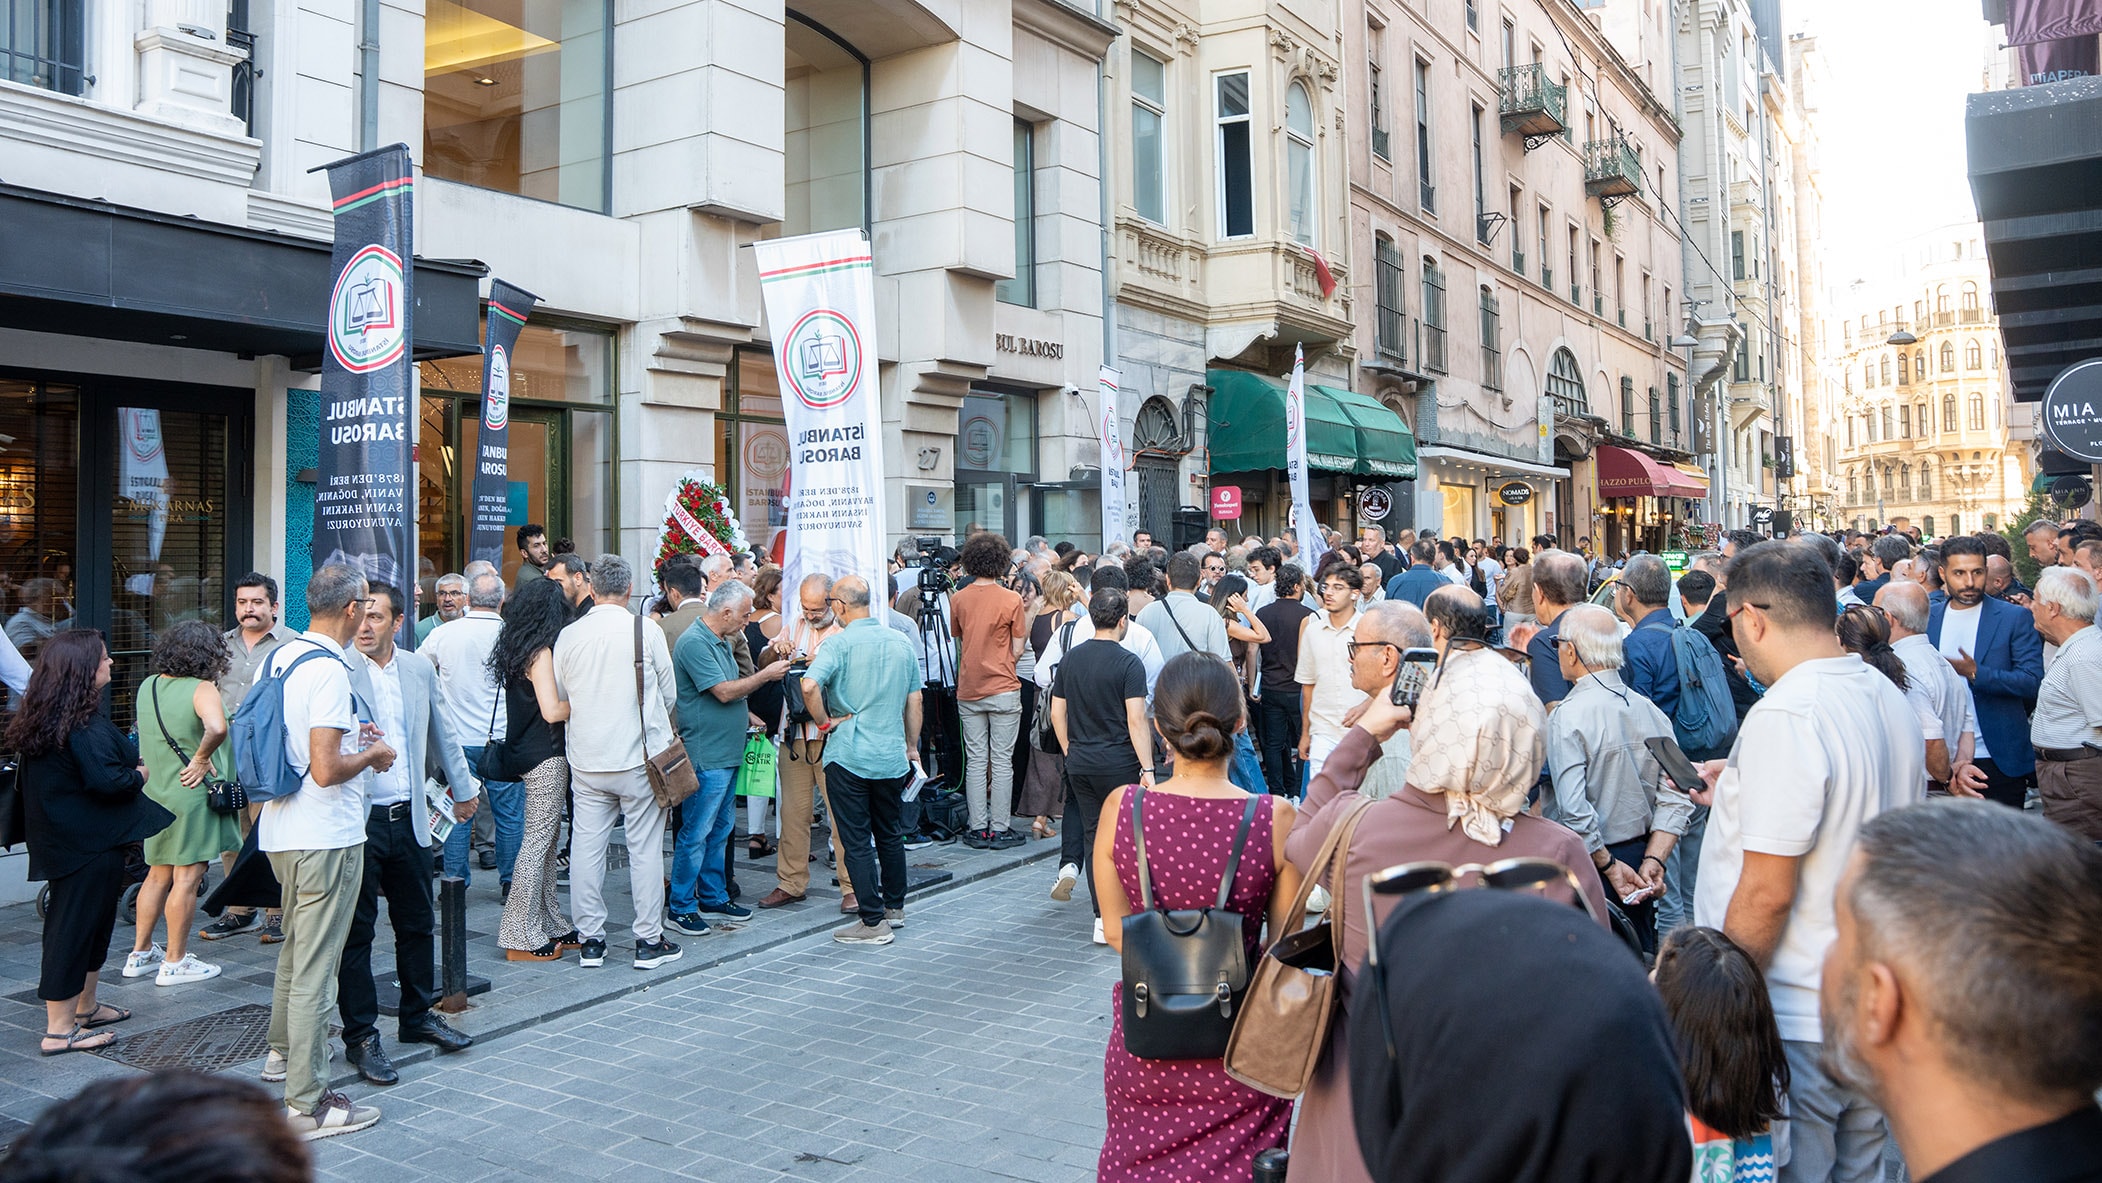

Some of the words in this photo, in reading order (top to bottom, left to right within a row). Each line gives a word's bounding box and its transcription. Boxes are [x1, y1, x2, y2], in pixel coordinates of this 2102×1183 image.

[1018, 338, 1063, 359] BAROSU
[2054, 402, 2095, 418] MIA
[918, 447, 941, 470] 27
[129, 499, 213, 513] MUKARNAS
